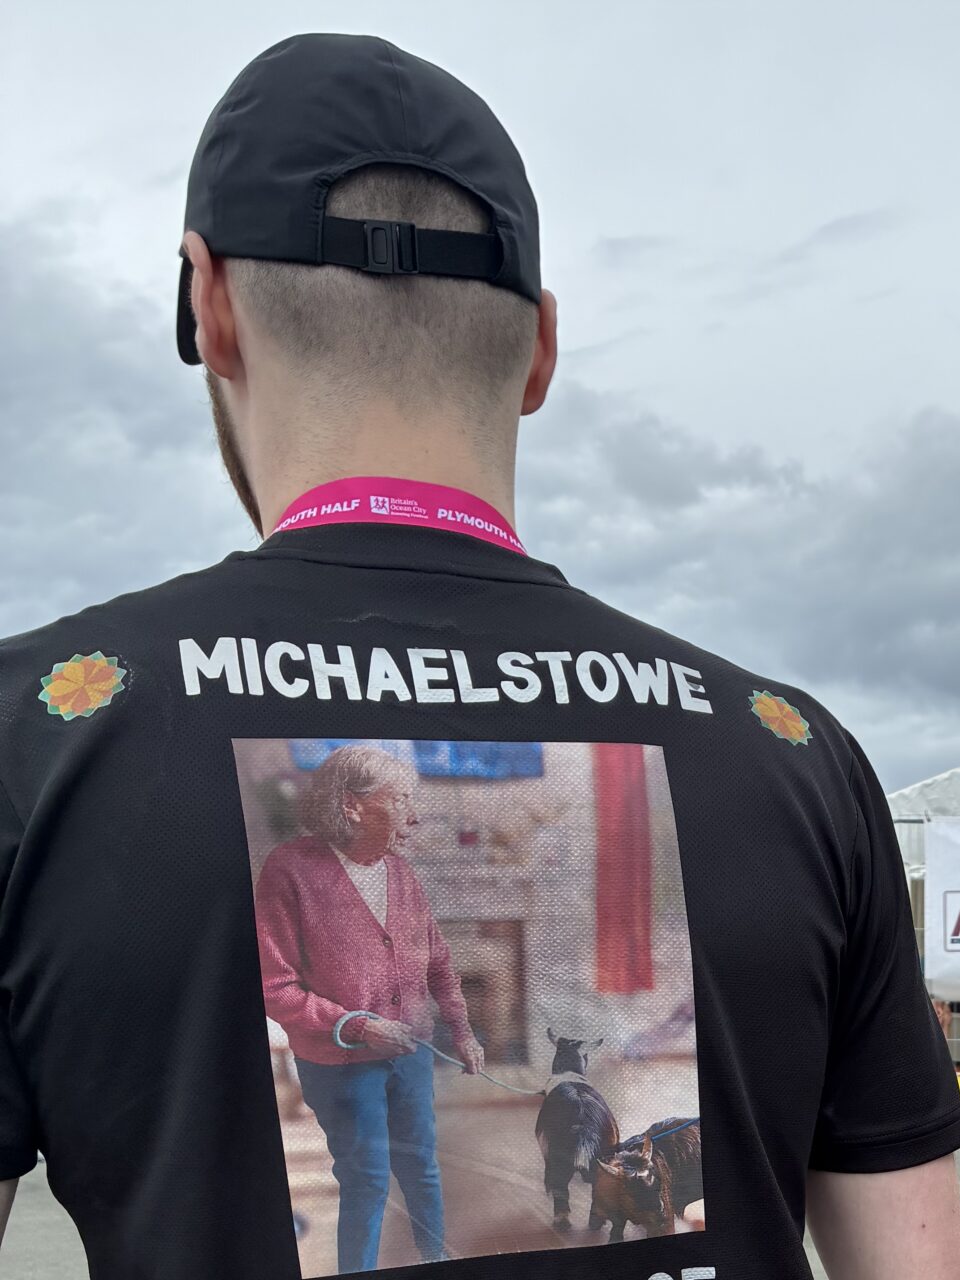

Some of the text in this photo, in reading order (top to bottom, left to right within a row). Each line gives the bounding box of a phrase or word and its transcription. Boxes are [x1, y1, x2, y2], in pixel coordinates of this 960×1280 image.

[321, 499, 360, 515] HALF
[437, 508, 508, 540] PLYMOUTH
[178, 636, 714, 714] MICHAELSTOWE
